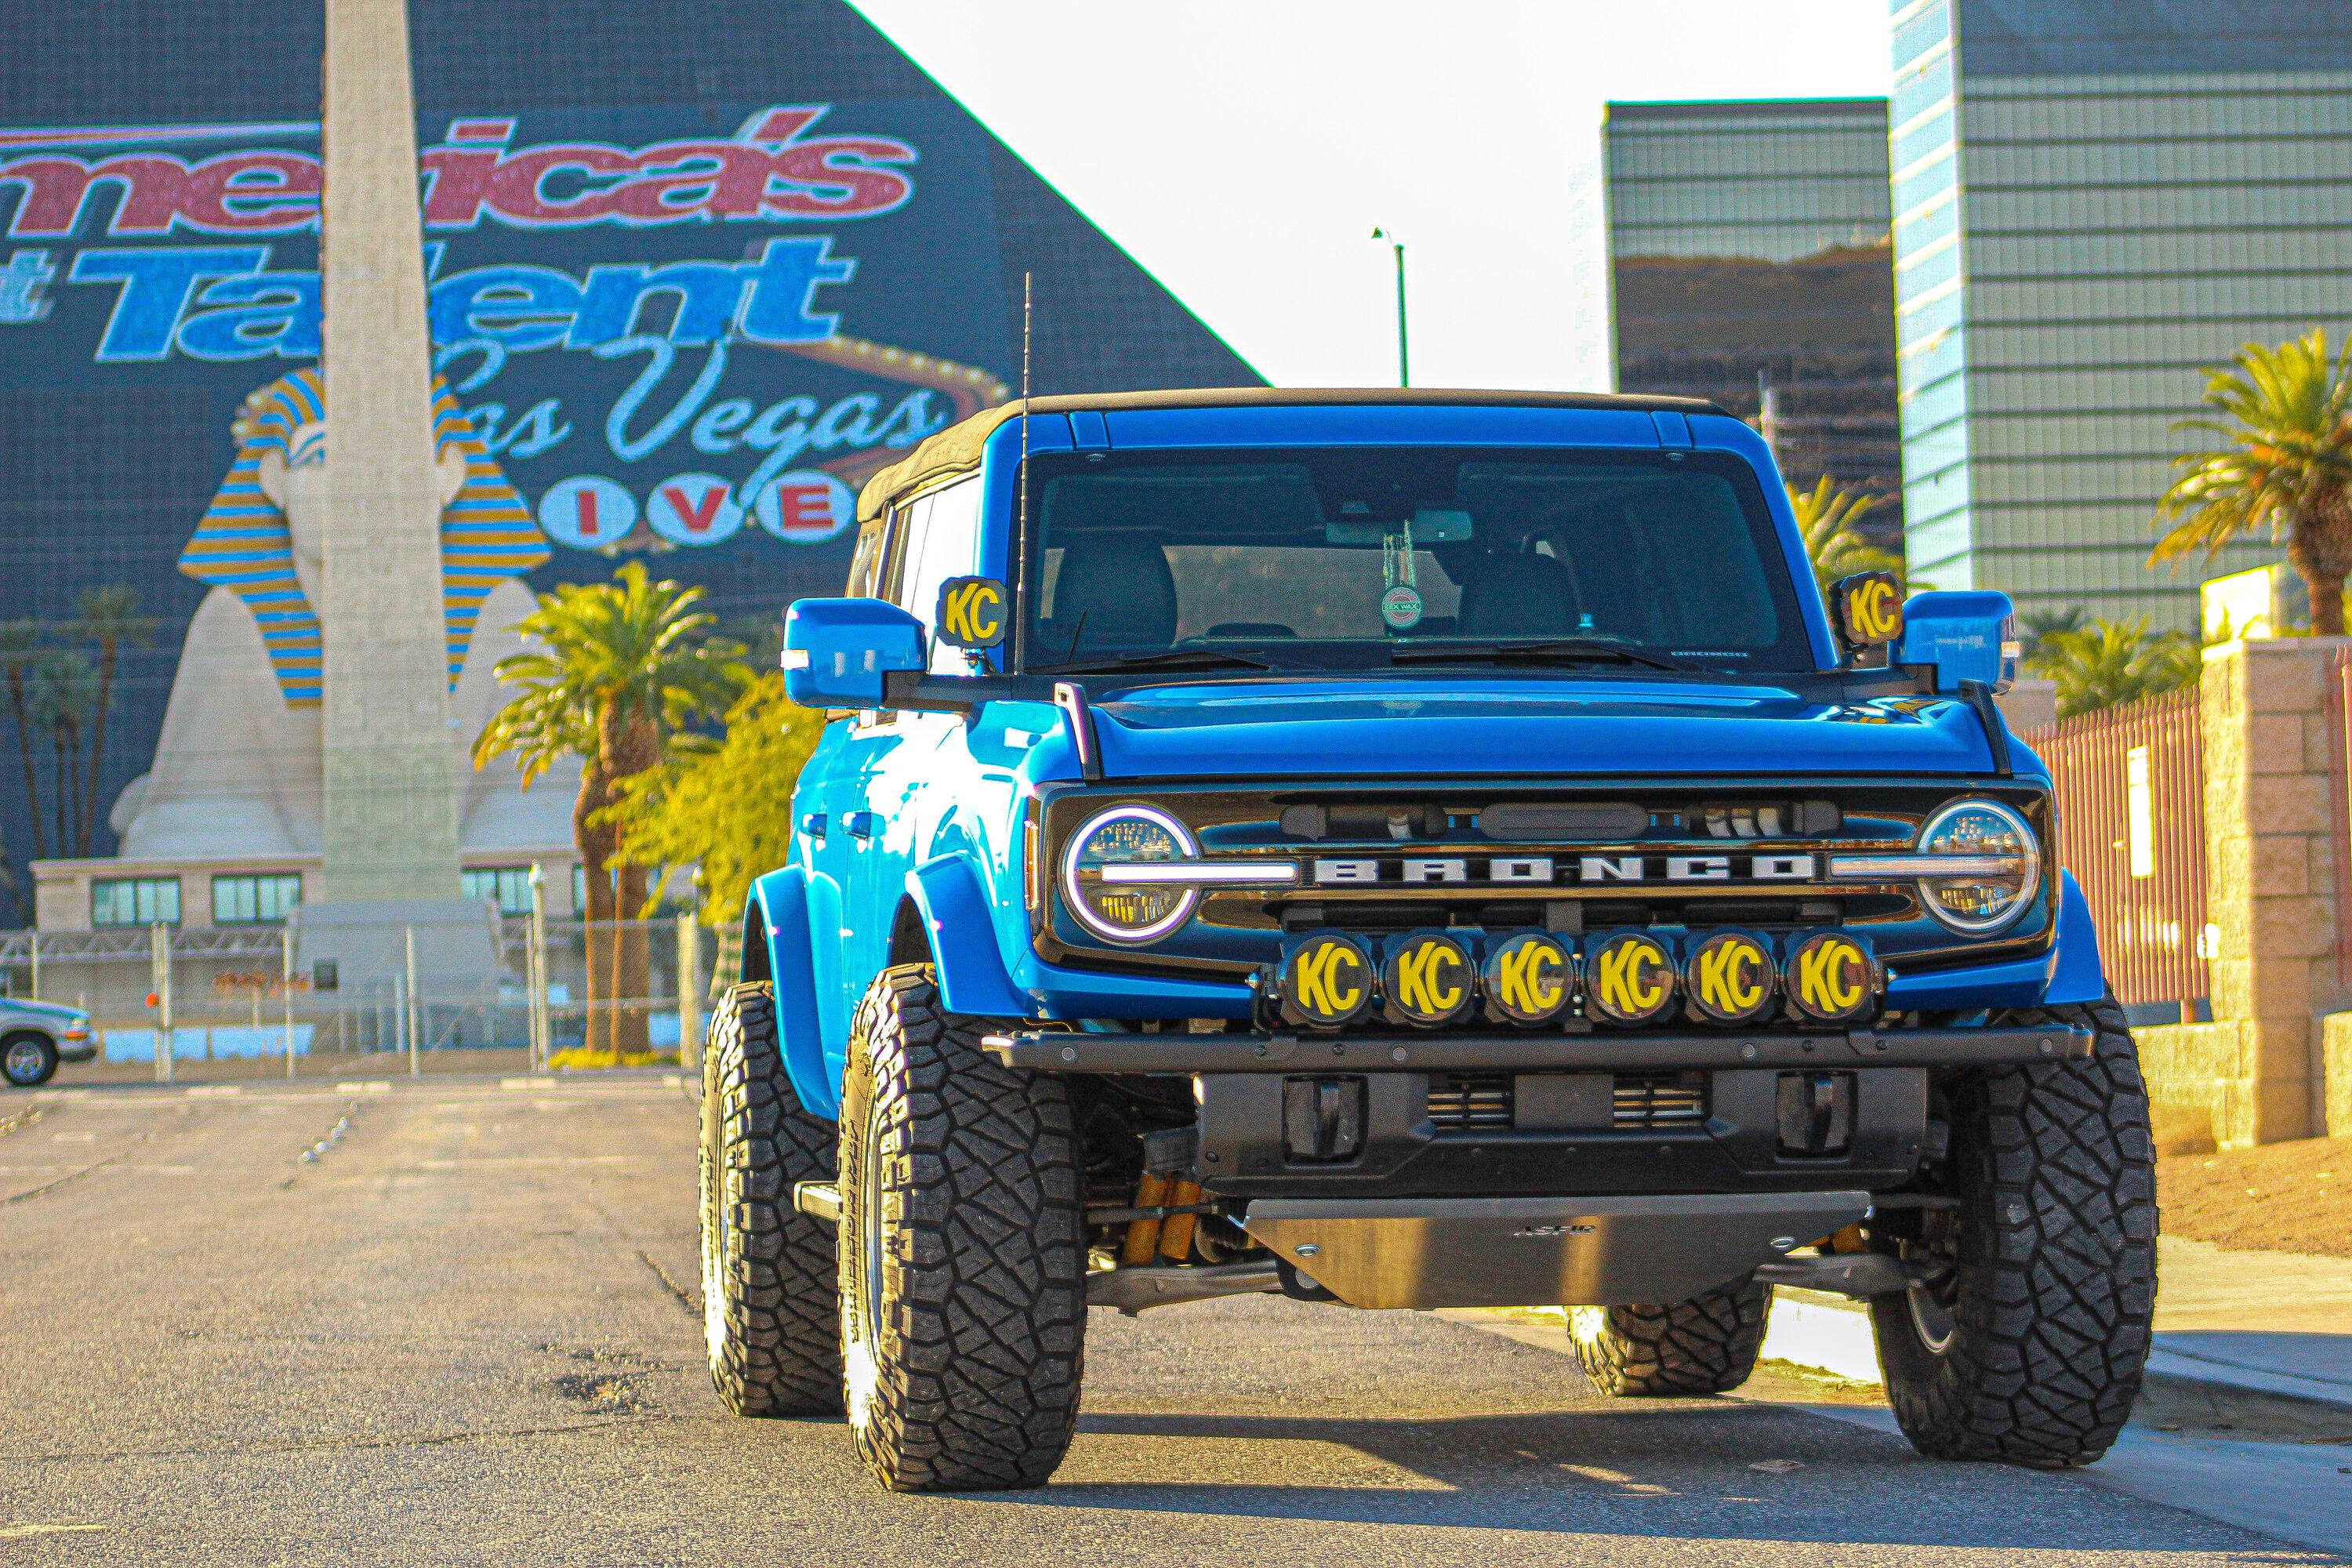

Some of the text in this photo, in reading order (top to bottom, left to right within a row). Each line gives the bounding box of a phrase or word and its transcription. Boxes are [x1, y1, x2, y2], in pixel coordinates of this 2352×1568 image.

[0, 103, 918, 238] meica's
[68, 236, 857, 363] Taent
[592, 333, 946, 510] Vegas
[575, 484, 848, 535] IVE
[946, 583, 1000, 642] KC
[1850, 579, 1895, 637] KC
[1314, 855, 1814, 883] BRONCO
[1298, 942, 1359, 1014] KC
[1399, 942, 1461, 1014] KC
[1500, 942, 1563, 1013] KC
[1600, 941, 1663, 1012] KC
[1700, 940, 1762, 1011] KC
[1800, 940, 1863, 1011] KC
